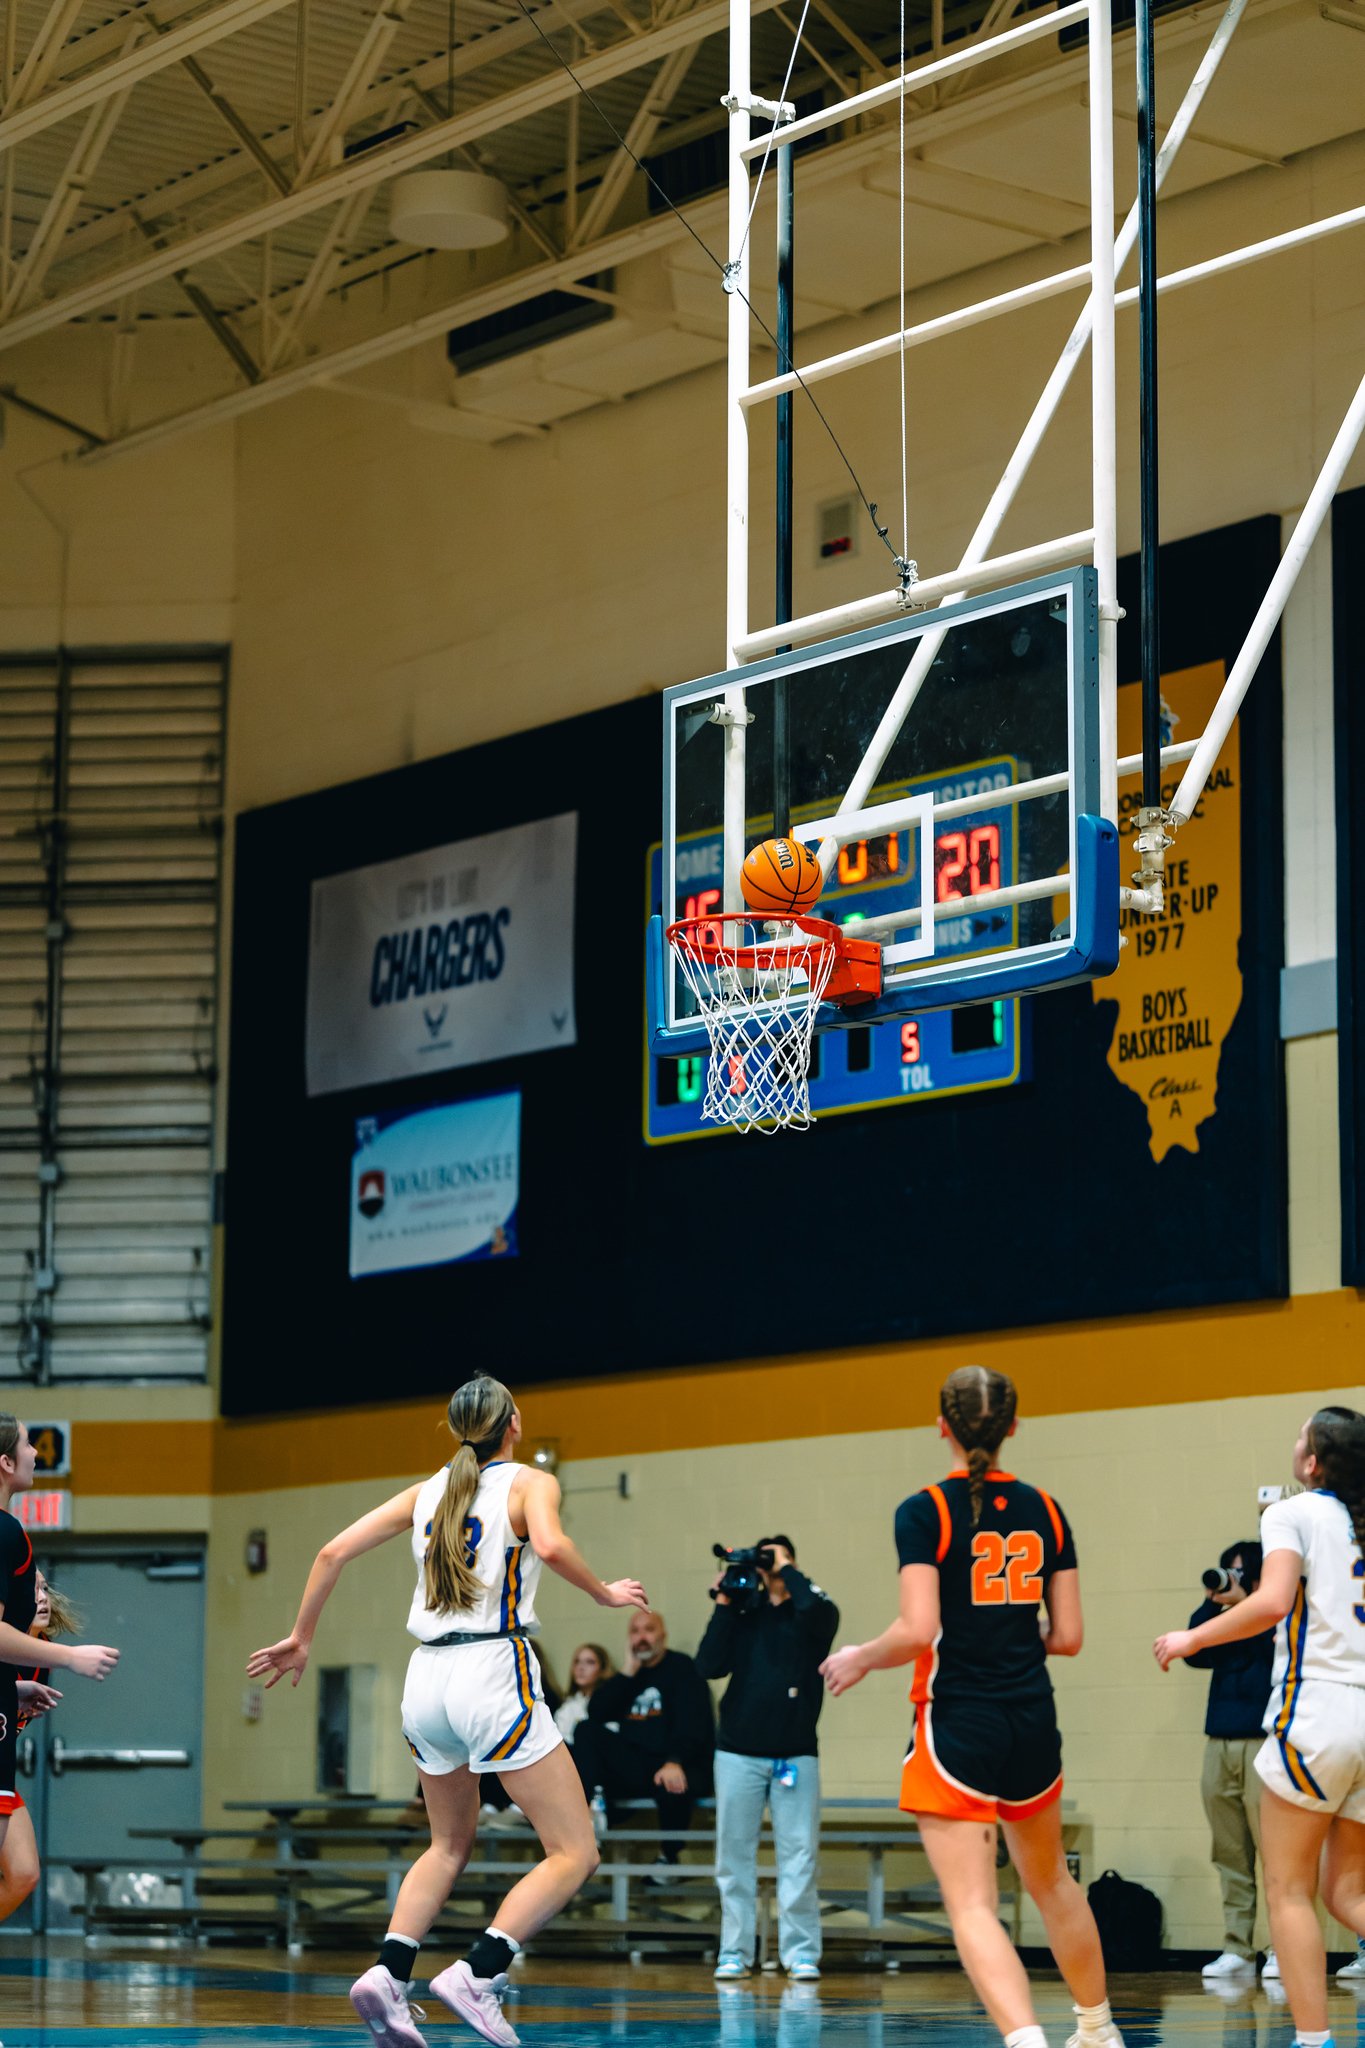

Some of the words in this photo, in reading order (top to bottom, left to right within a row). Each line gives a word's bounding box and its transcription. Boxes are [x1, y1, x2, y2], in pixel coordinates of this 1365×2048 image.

[676, 842, 722, 883] OME
[937, 824, 1000, 904] 20
[369, 906, 511, 1008] CHARGERS
[1135, 922, 1185, 957] 1977
[1142, 986, 1188, 1024] BOYS
[901, 1021, 920, 1063] 5
[1118, 1017, 1213, 1063] BASKETBALL
[899, 1062, 935, 1094] TOL
[1168, 1098, 1182, 1119] A
[971, 1530, 1044, 1606] 22
